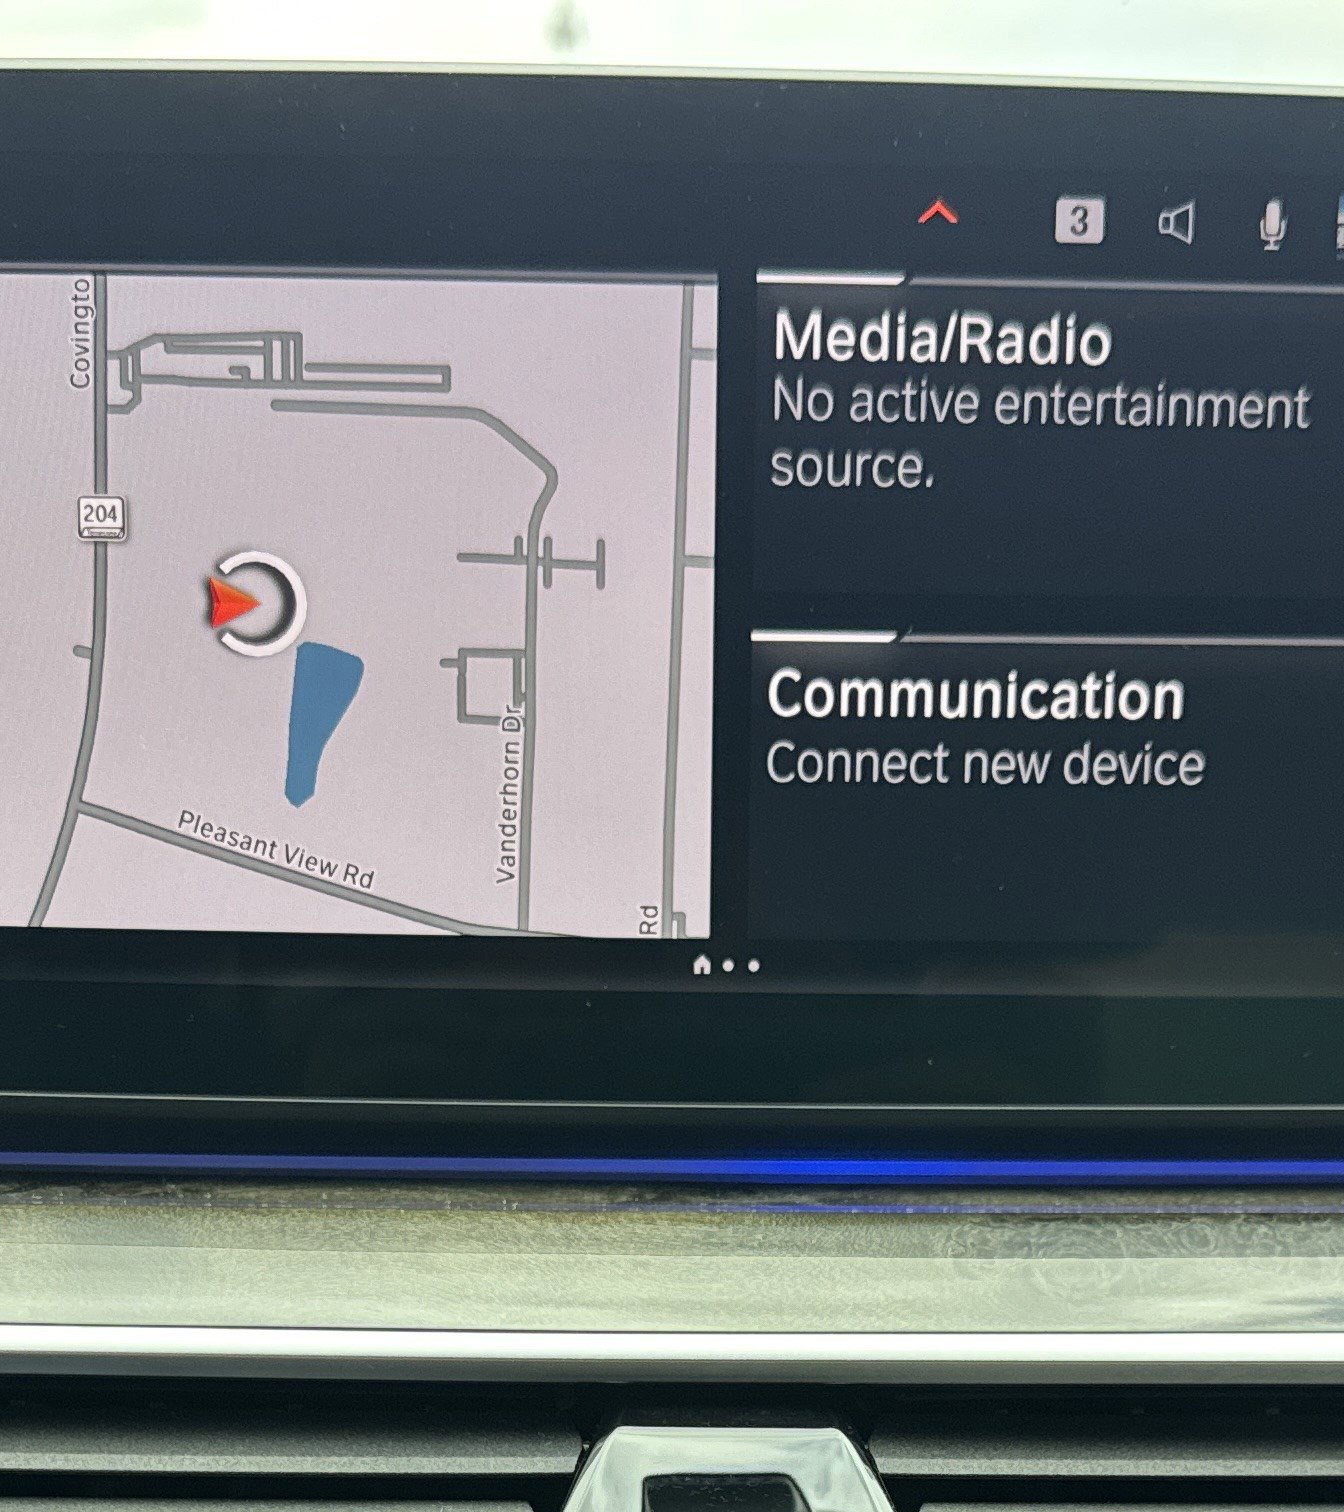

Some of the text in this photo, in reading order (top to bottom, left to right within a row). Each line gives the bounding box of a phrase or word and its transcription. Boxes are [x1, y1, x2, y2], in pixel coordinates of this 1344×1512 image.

[1069, 205, 1089, 236] 3
[70, 279, 95, 389] Covingto
[773, 309, 1114, 367] Media/Radio
[771, 378, 1311, 431] No active entertainment
[770, 449, 935, 490] source.
[84, 504, 117, 522] 204
[768, 668, 1185, 722] Communication
[766, 740, 1206, 787] Connect new device
[496, 704, 523, 884] Vanderhorn Dr
[178, 809, 375, 890] Pleasant View Rd
[640, 904, 659, 937] Rd
